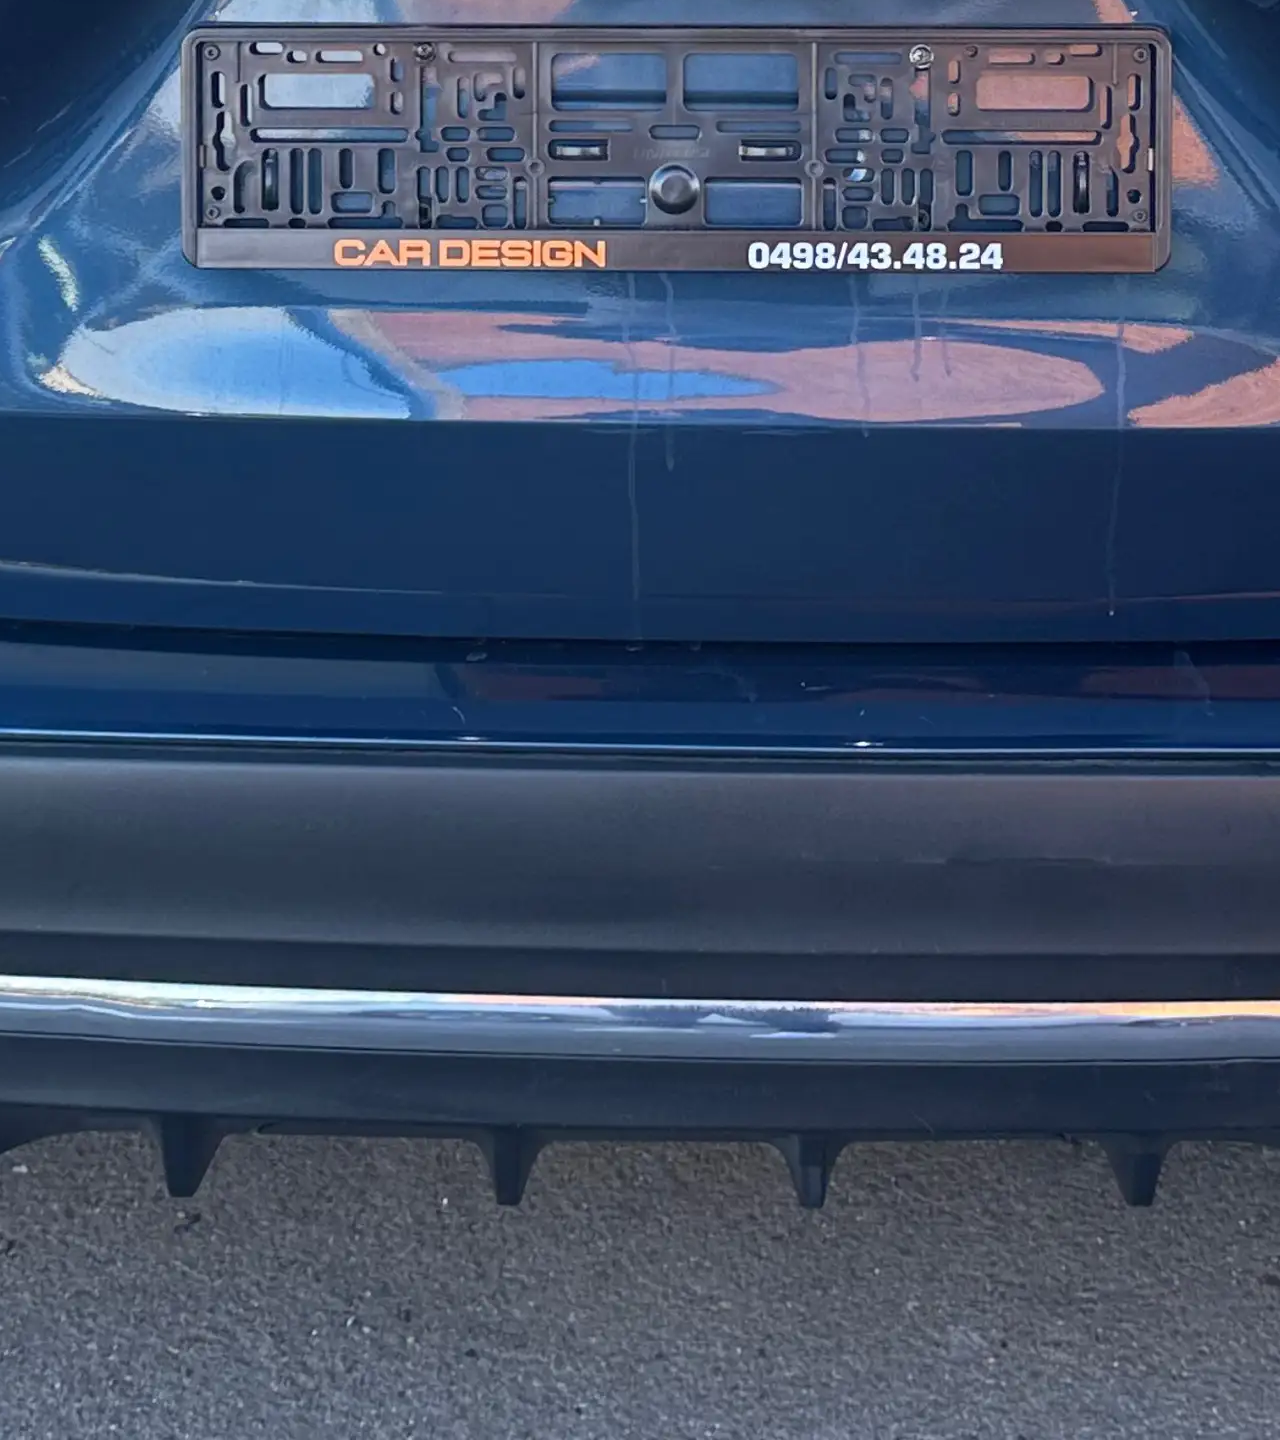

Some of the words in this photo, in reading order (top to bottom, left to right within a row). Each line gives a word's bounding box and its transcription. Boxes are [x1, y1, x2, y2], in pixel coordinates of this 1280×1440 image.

[333, 238, 431, 268] CAR
[438, 239, 607, 268] DESIGN
[747, 240, 1004, 271] 0498/43.48.24
